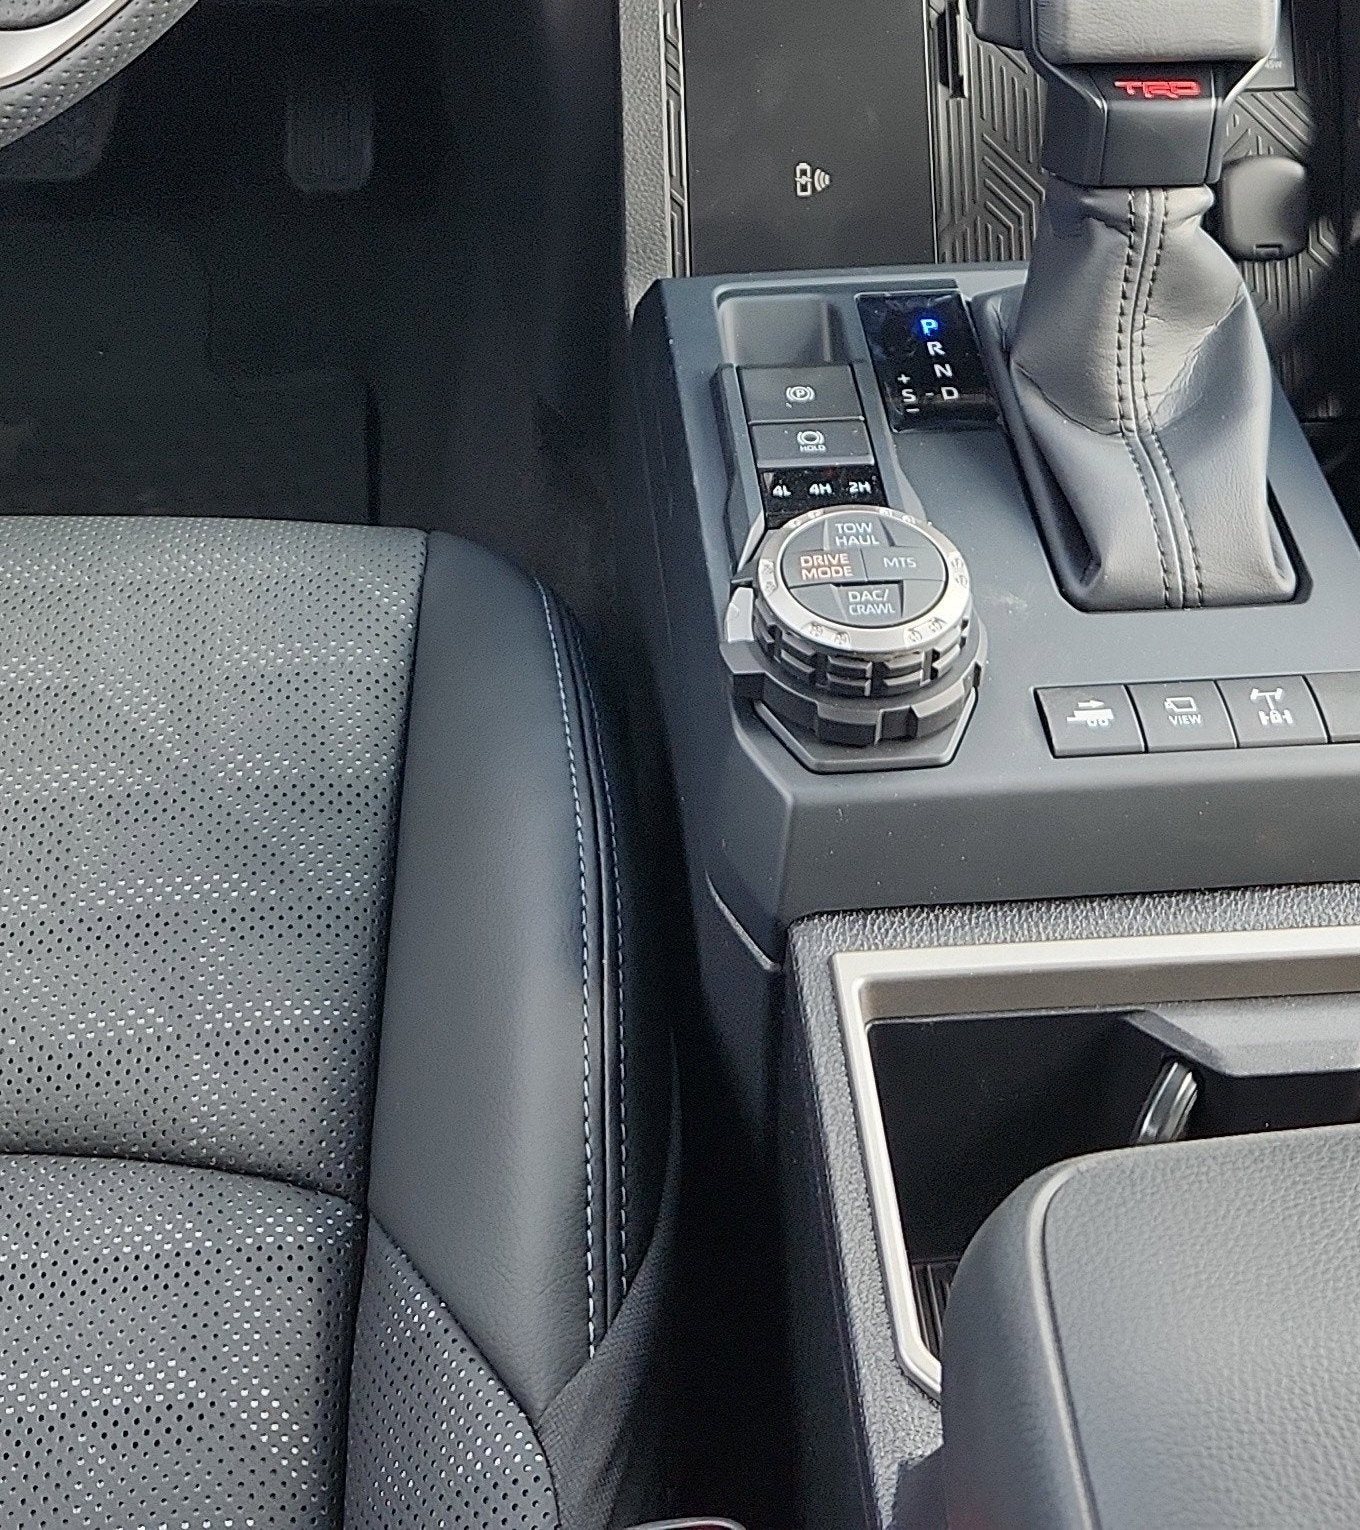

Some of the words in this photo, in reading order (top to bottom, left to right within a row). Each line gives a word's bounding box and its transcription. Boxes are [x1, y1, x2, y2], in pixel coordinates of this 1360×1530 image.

[1113, 78, 1202, 99] TRD
[920, 318, 939, 337] P
[926, 341, 946, 356] R
[933, 363, 953, 378] N
[901, 388, 917, 403] S
[940, 386, 959, 401] D
[800, 444, 827, 453] HOLD
[772, 485, 792, 497] 4L
[809, 483, 833, 495] 4H
[848, 481, 872, 493] 2H
[835, 522, 873, 533] TOW
[835, 534, 880, 546] HAUL
[800, 553, 850, 567] DRIVE
[883, 556, 917, 569] MTS
[801, 565, 853, 581] MODE
[848, 587, 889, 603] DAC/
[848, 601, 896, 616] CRAWL
[1168, 712, 1202, 727] VIEW
